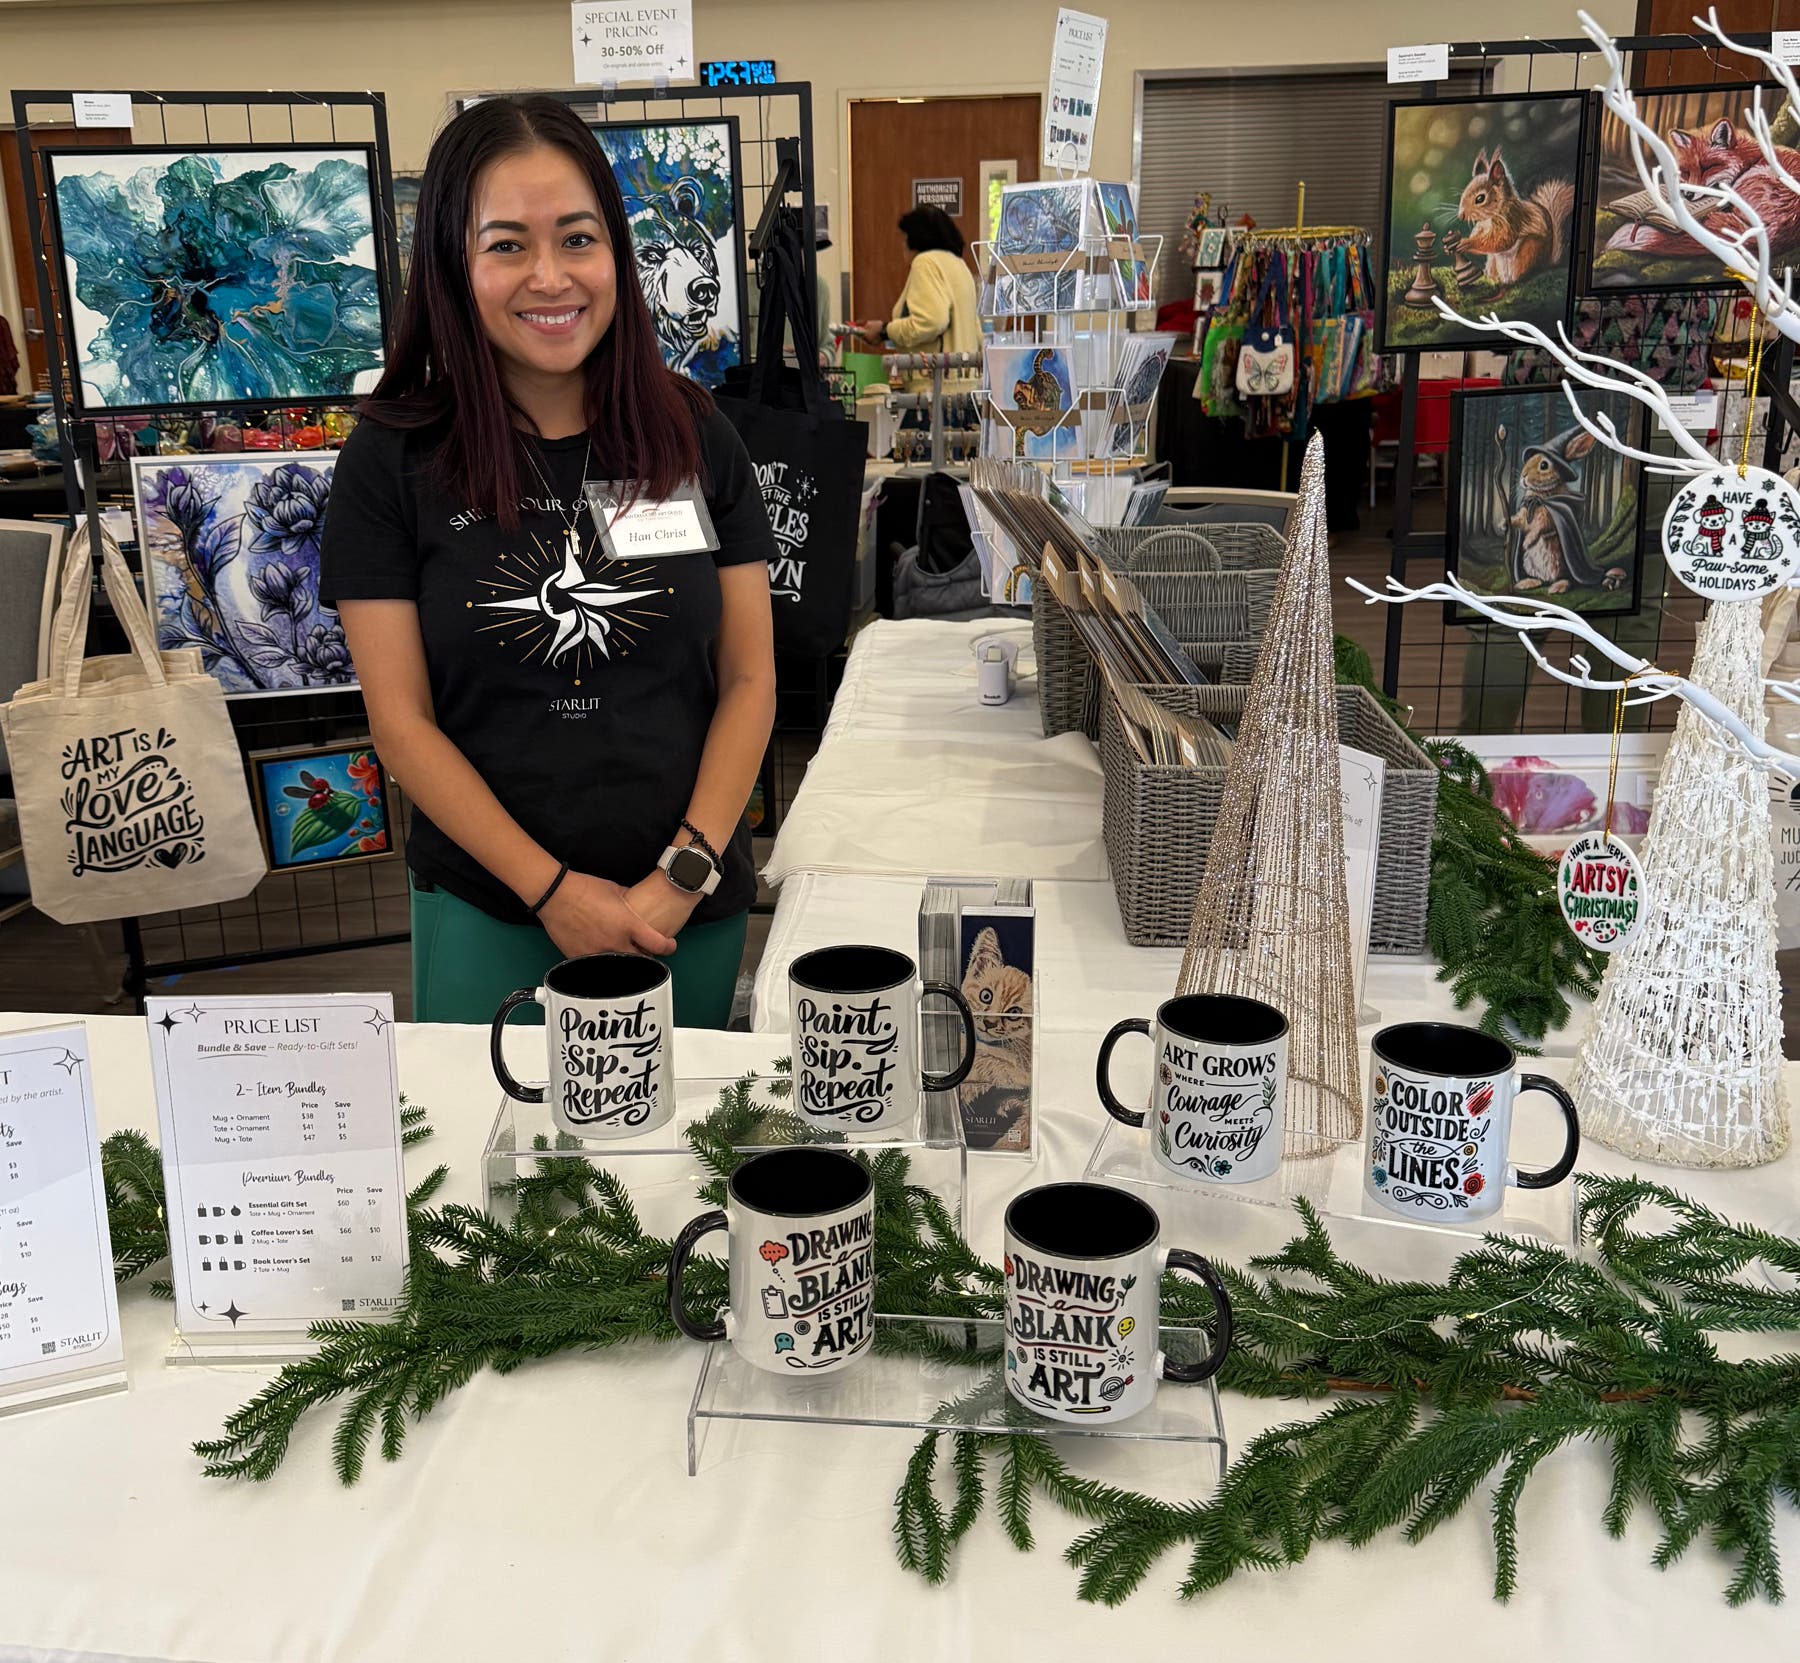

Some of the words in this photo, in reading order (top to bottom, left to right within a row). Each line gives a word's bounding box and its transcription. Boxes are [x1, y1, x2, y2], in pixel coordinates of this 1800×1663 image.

[585, 11, 634, 24] SPECIAL
[637, 8, 678, 22] EVENT
[605, 25, 659, 38] PRICING
[601, 46, 643, 57] 30-50%
[646, 44, 664, 55] Off
[917, 184, 958, 193] AUTHORIZED
[918, 194, 957, 203] PERSONNEL
[772, 489, 792, 505] THE
[1722, 491, 1753, 504] HAVE
[629, 532, 651, 542] Han
[655, 529, 687, 540] Christ
[1728, 533, 1737, 545] A
[1699, 576, 1756, 591] HOLIDAYS
[548, 697, 601, 711] STARLIT
[62, 728, 136, 780] ART
[133, 733, 152, 752] IS
[97, 766, 120, 784] MY
[73, 795, 201, 877] LANGUAGE
[1570, 839, 1590, 859] HAVE
[1593, 839, 1599, 850] A
[1571, 861, 1629, 897] ARTSY
[560, 999, 656, 1042] Paint.
[798, 997, 891, 1035] Paint.
[224, 1019, 280, 1034] PRICE
[285, 1018, 320, 1033] LIST
[198, 1044, 230, 1052] Bundle
[277, 1042, 336, 1053] Ready-to-Gift
[338, 1041, 359, 1050] Sets!
[565, 1045, 629, 1085] Sip.
[802, 1036, 861, 1078] Sip.
[1163, 1041, 1198, 1071] ART
[1202, 1052, 1276, 1077] GROWS
[563, 1059, 660, 1117] Repeat.
[801, 1058, 895, 1109] Repeat.
[1174, 1071, 1205, 1087] WHERE
[11, 1095, 21, 1104] by
[24, 1091, 37, 1101] the
[40, 1087, 64, 1098] artist.
[256, 1081, 283, 1096] Item
[285, 1081, 326, 1098] Bundles
[1391, 1080, 1464, 1117] COLOR
[1167, 1085, 1246, 1122] Courage
[1224, 1117, 1254, 1125] MEETS
[1386, 1105, 1470, 1142] OUTSIDE
[6, 1139, 22, 1147] Save
[1174, 1121, 1263, 1161] Curiosity
[1409, 1141, 1437, 1156] the
[1387, 1145, 1460, 1190] LINES
[242, 1171, 291, 1187] Premium
[294, 1169, 335, 1186] Bundles
[9, 1207, 20, 1215] oz)
[16, 1219, 33, 1227] Save
[786, 1209, 873, 1267] DRAWING
[1013, 1253, 1116, 1304] DRAWING
[360, 1298, 398, 1307] STARLIT
[818, 1307, 830, 1322] IS
[834, 1291, 864, 1315] STILL
[811, 1293, 870, 1356] ART
[1014, 1303, 1117, 1347] BLANK
[60, 1331, 102, 1347] STARLIT
[1034, 1347, 1046, 1360] IS
[1050, 1349, 1093, 1368] STILL
[1028, 1362, 1106, 1405] ART
